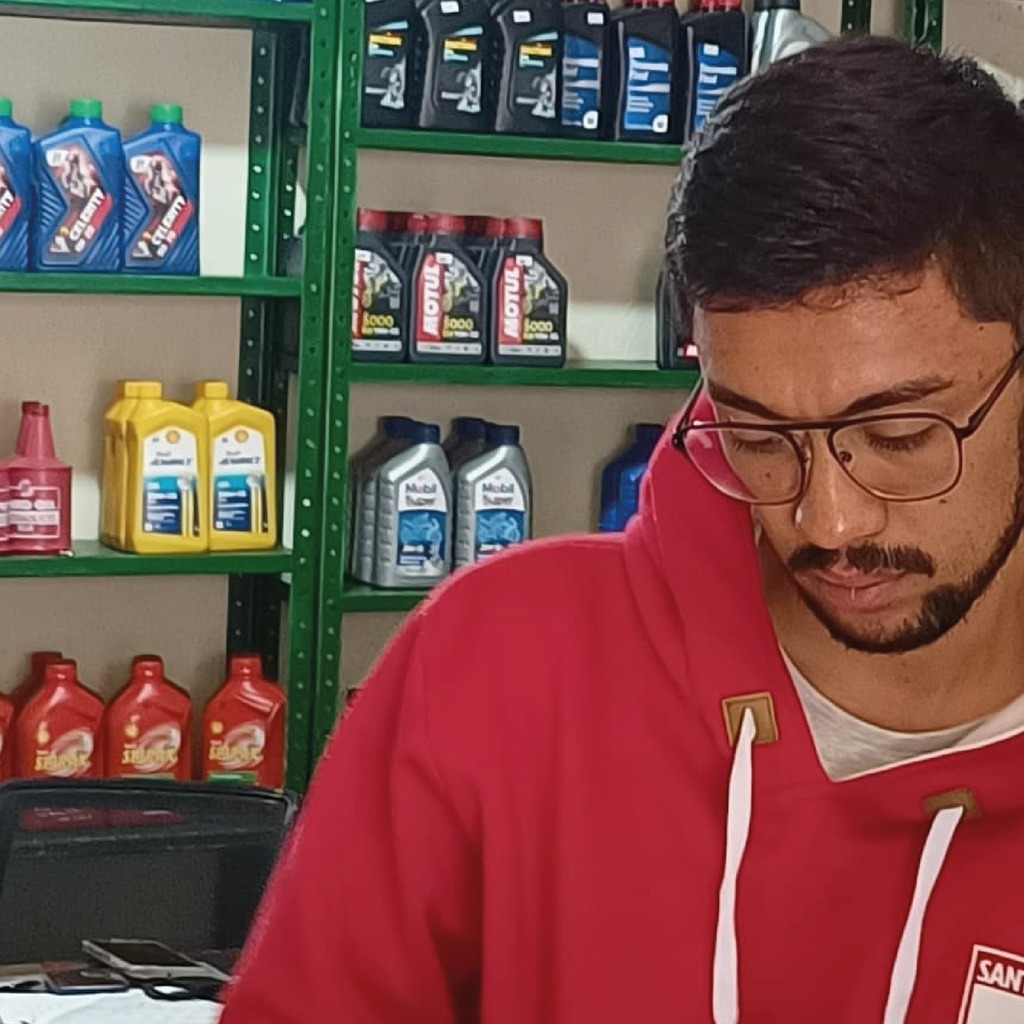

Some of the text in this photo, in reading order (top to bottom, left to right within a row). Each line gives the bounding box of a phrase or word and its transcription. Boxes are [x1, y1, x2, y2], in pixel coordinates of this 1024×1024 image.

[422, 262, 441, 337] MOTUL
[503, 265, 521, 339] MOTUL
[405, 483, 437, 493] Mobil
[482, 483, 515, 493] Mobil
